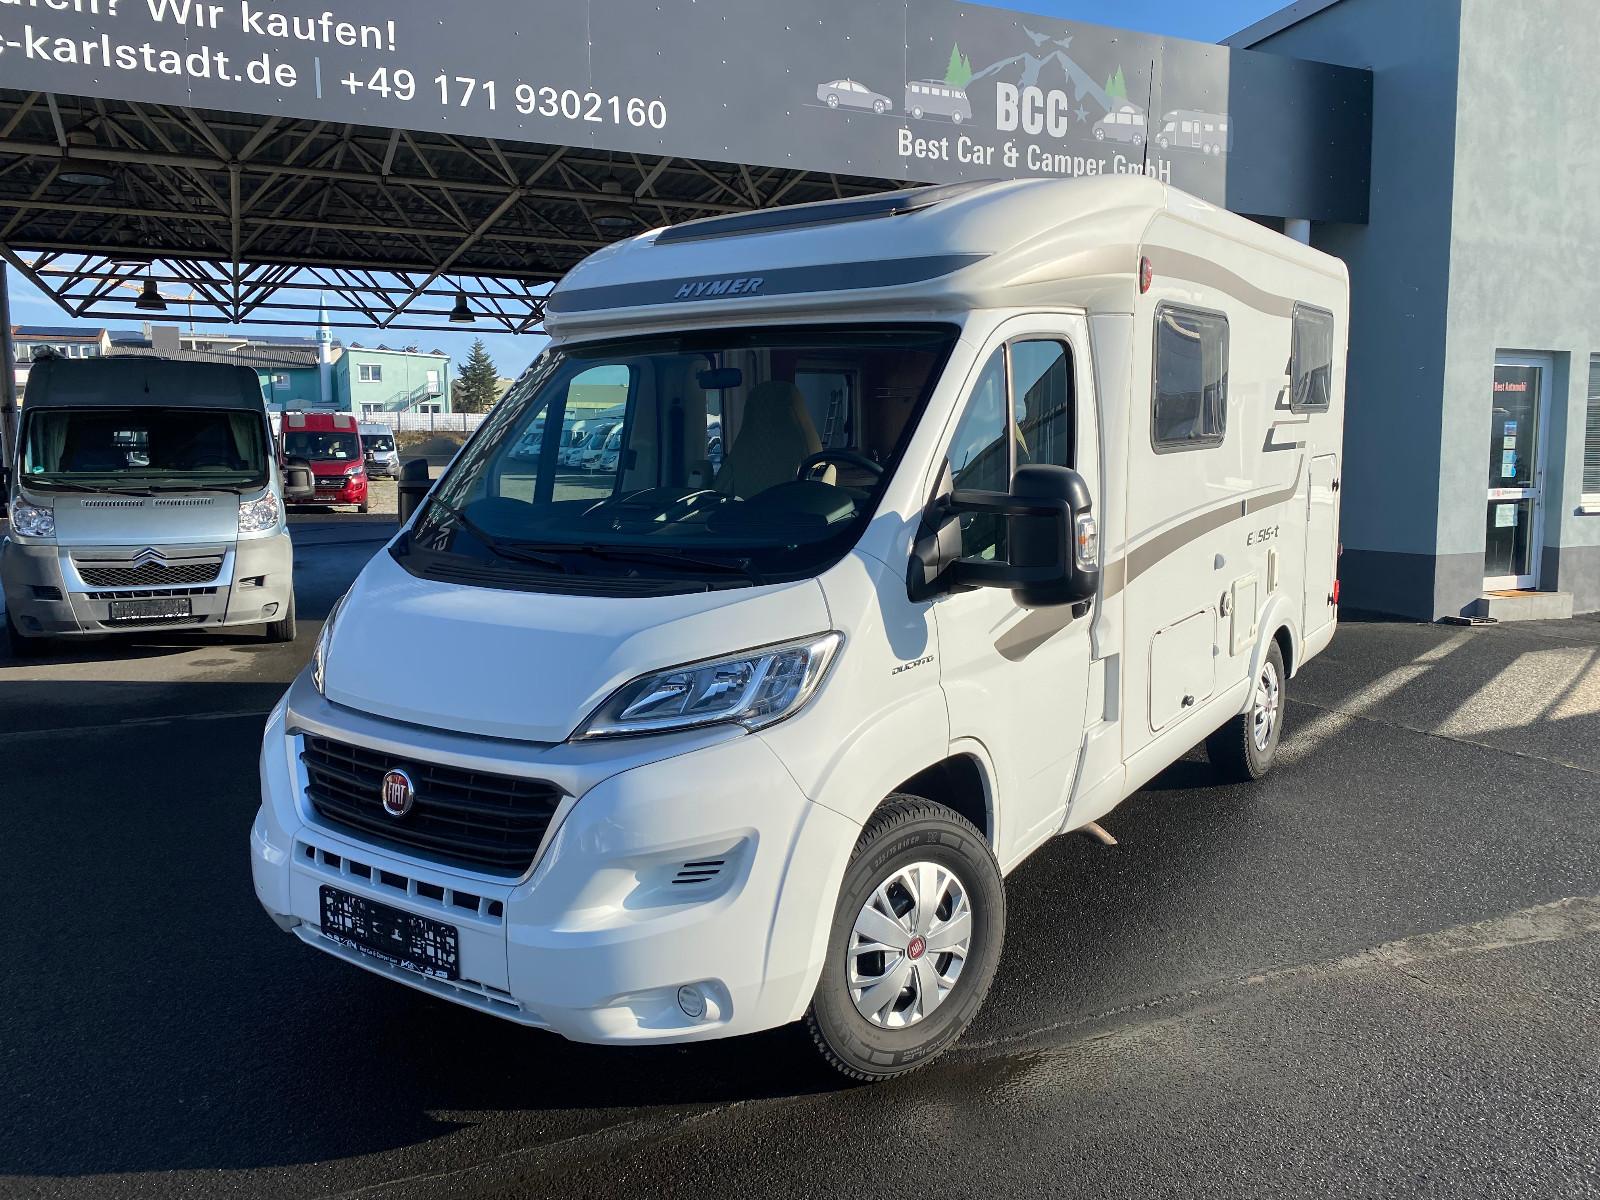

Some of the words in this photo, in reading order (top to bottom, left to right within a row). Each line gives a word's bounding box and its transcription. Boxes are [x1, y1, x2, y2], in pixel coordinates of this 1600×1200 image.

[241, 0, 396, 51] kaufen!
[0, 24, 297, 88] -karlstadt.de
[340, 67, 416, 101] +49
[434, 73, 497, 110] 171
[515, 84, 668, 129] 9302160
[996, 81, 1068, 138] BCC
[898, 128, 949, 160] Best
[957, 136, 995, 165] Car
[1003, 141, 1020, 168] &
[1027, 144, 1106, 178] Camper
[1113, 154, 1171, 184] GmbH
[674, 277, 765, 299] HYMER
[387, 781, 407, 805] FIAT
